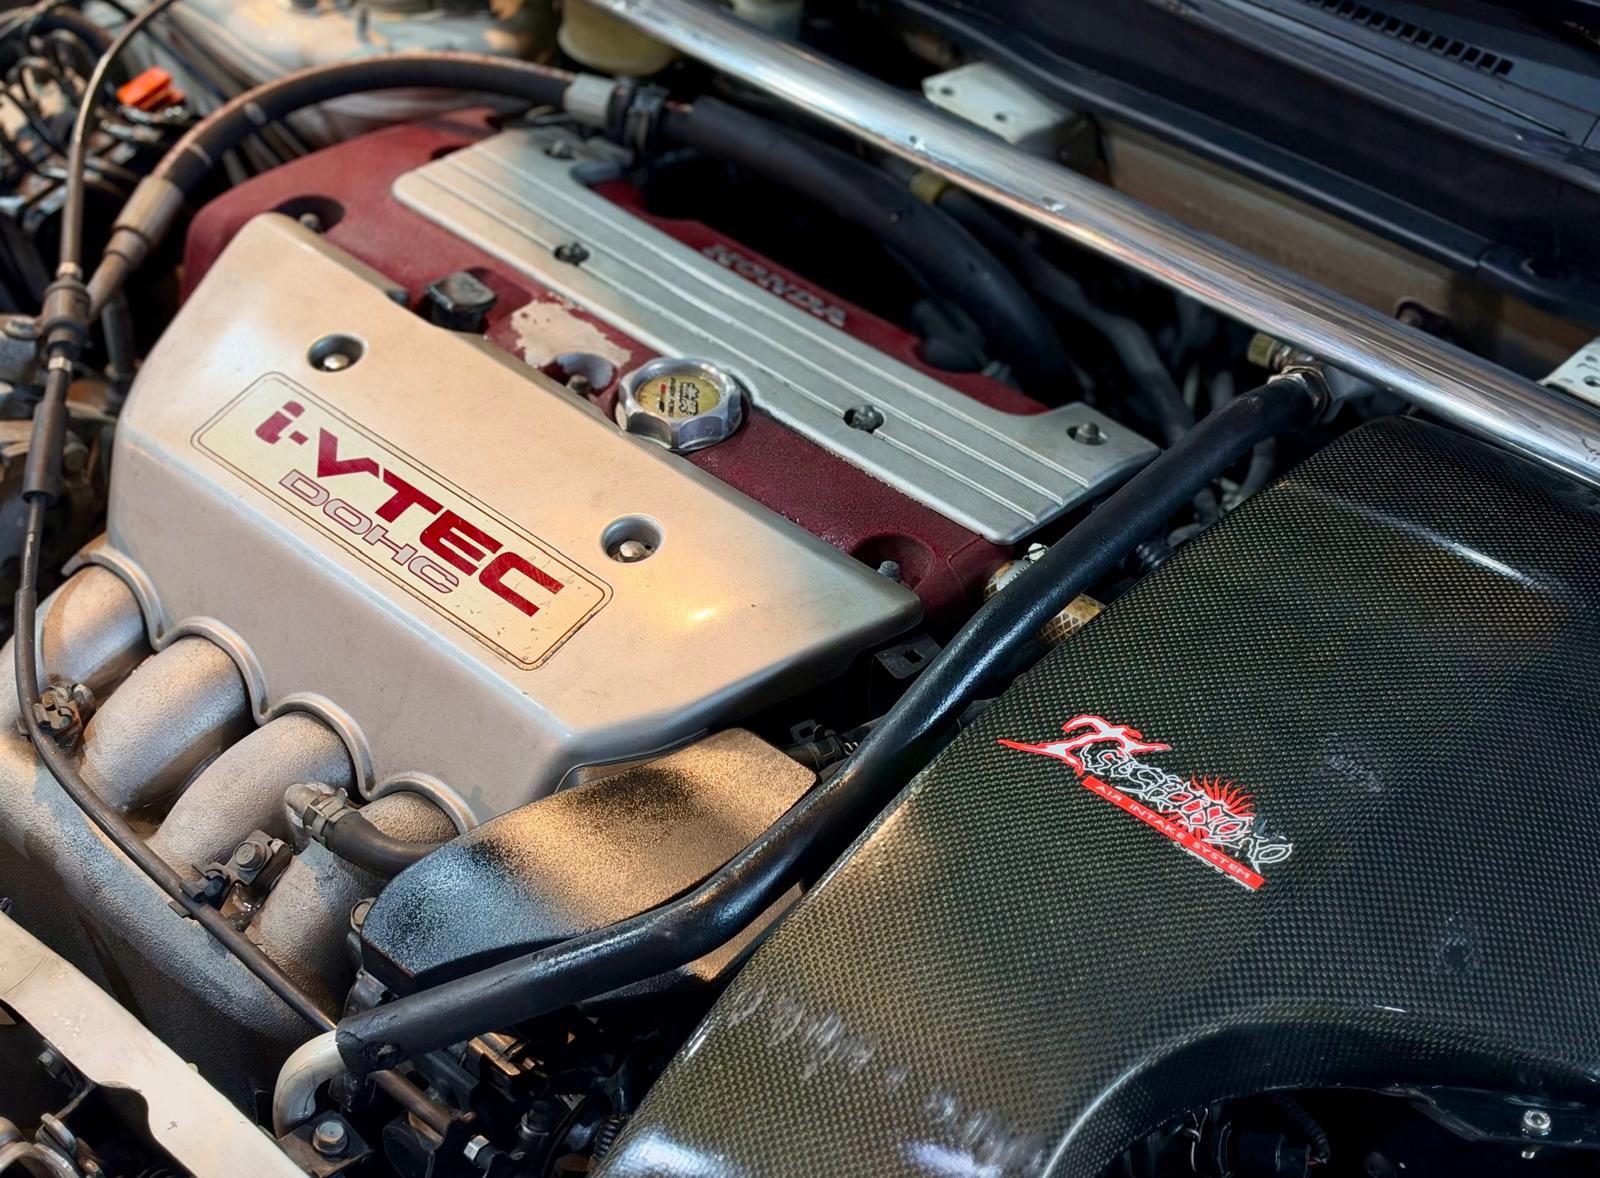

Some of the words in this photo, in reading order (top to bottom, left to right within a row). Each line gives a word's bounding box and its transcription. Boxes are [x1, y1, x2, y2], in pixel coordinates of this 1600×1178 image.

[702, 244, 846, 328] HONDA
[256, 401, 564, 617] i-VTEC
[279, 469, 460, 594] DOHC
[1096, 785, 1123, 802] AIR
[1129, 803, 1186, 840] INTAKE
[1194, 841, 1251, 880] SYSTEM
